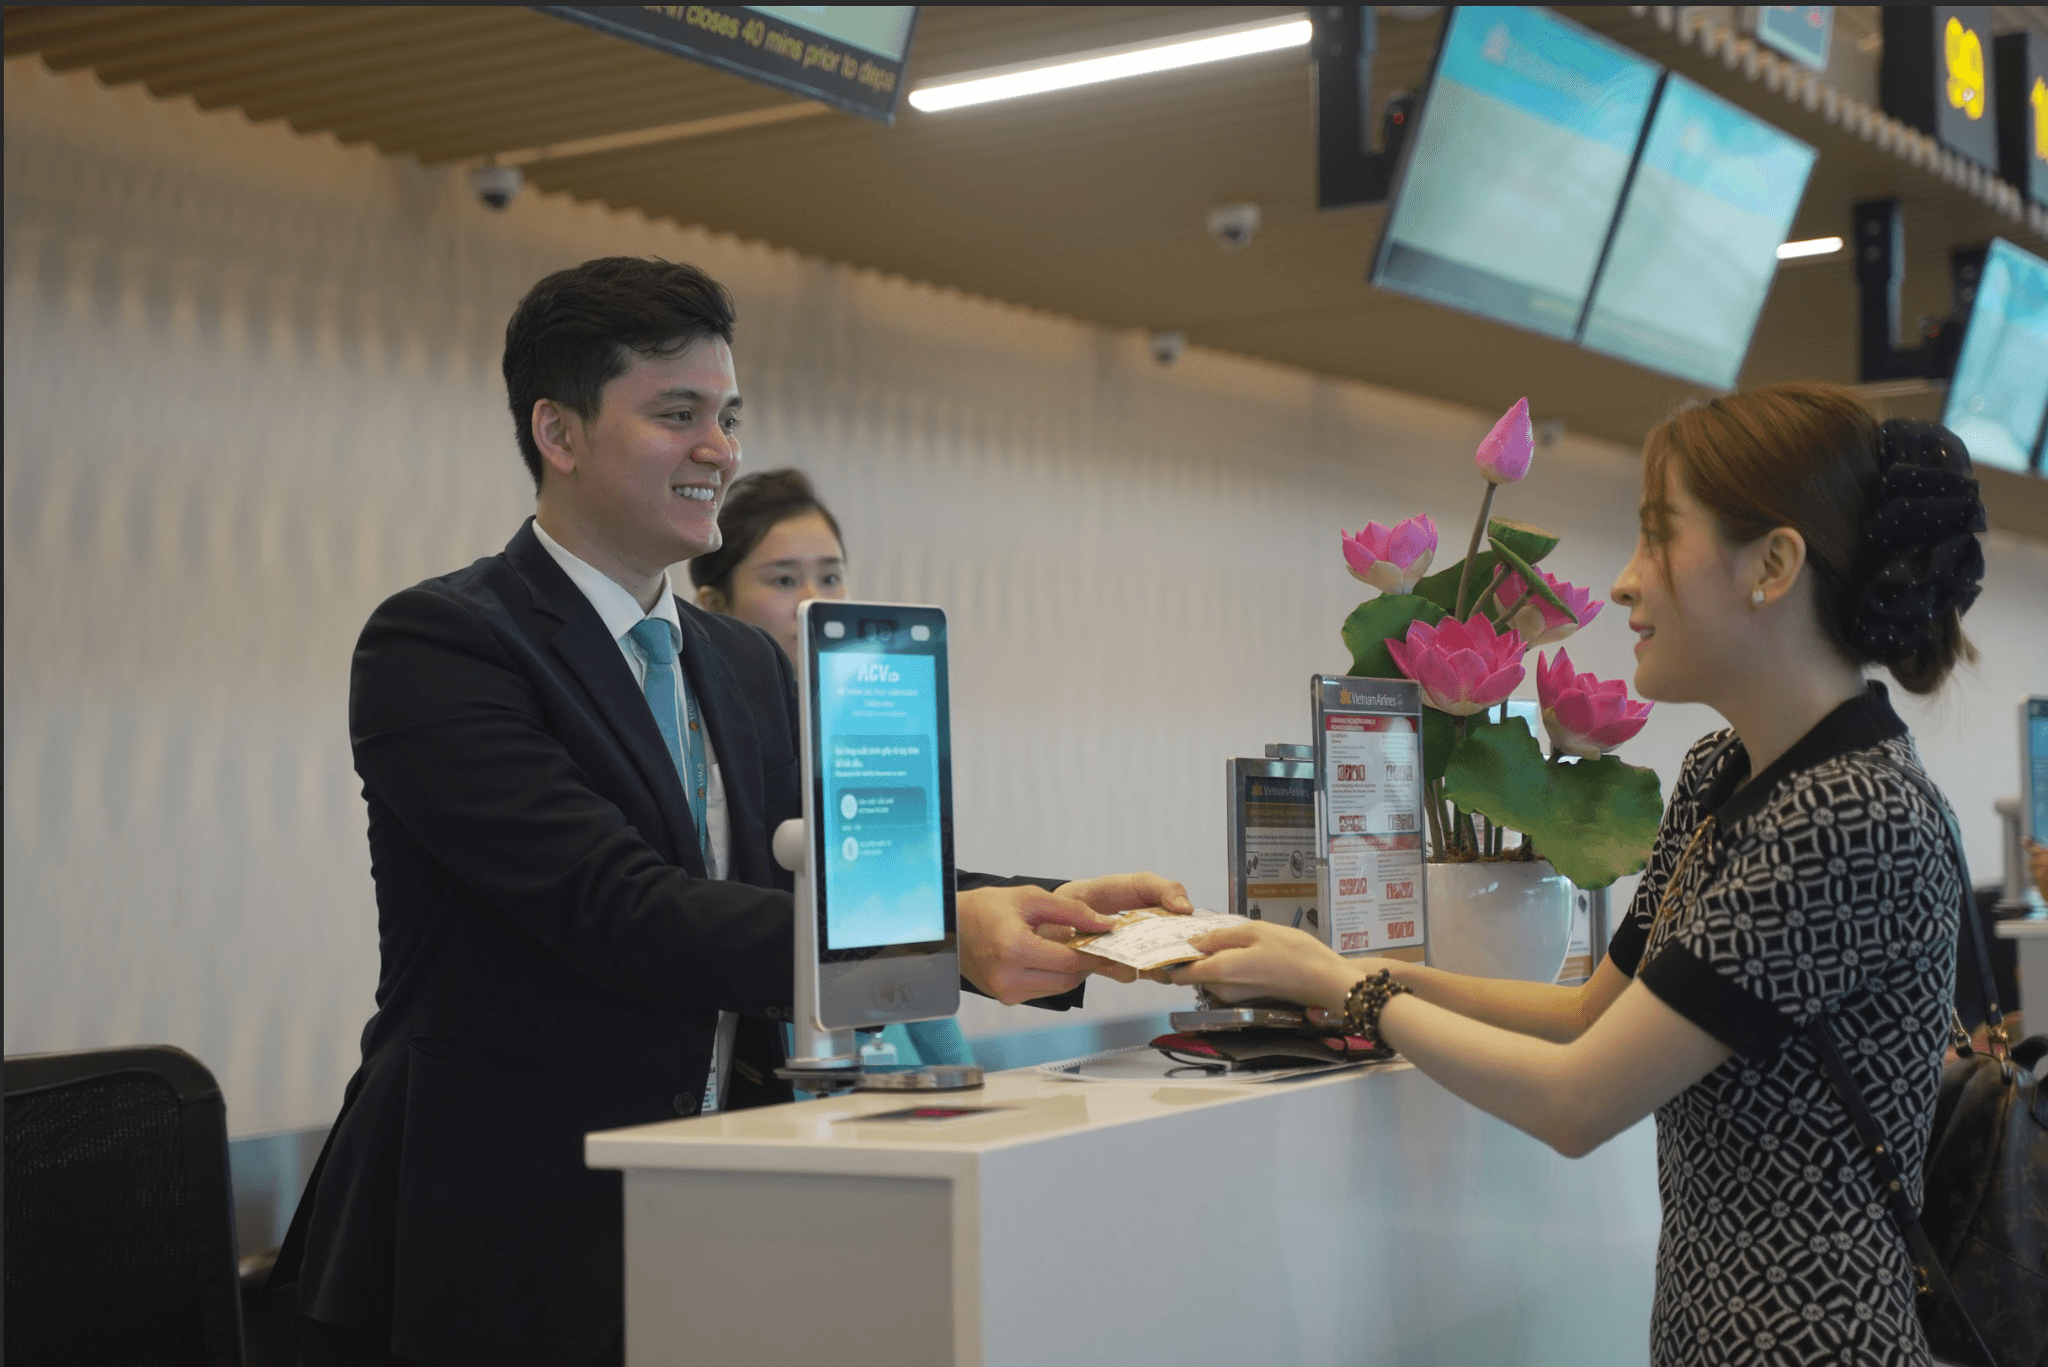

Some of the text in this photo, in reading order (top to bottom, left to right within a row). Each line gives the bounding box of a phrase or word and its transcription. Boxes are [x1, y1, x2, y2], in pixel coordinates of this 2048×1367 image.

[686, 6, 740, 39] closes
[741, 18, 765, 47] 40
[764, 29, 804, 62] mins
[802, 44, 840, 73] prior
[841, 52, 858, 79] to
[1351, 692, 1397, 707] Vietnam Airlines
